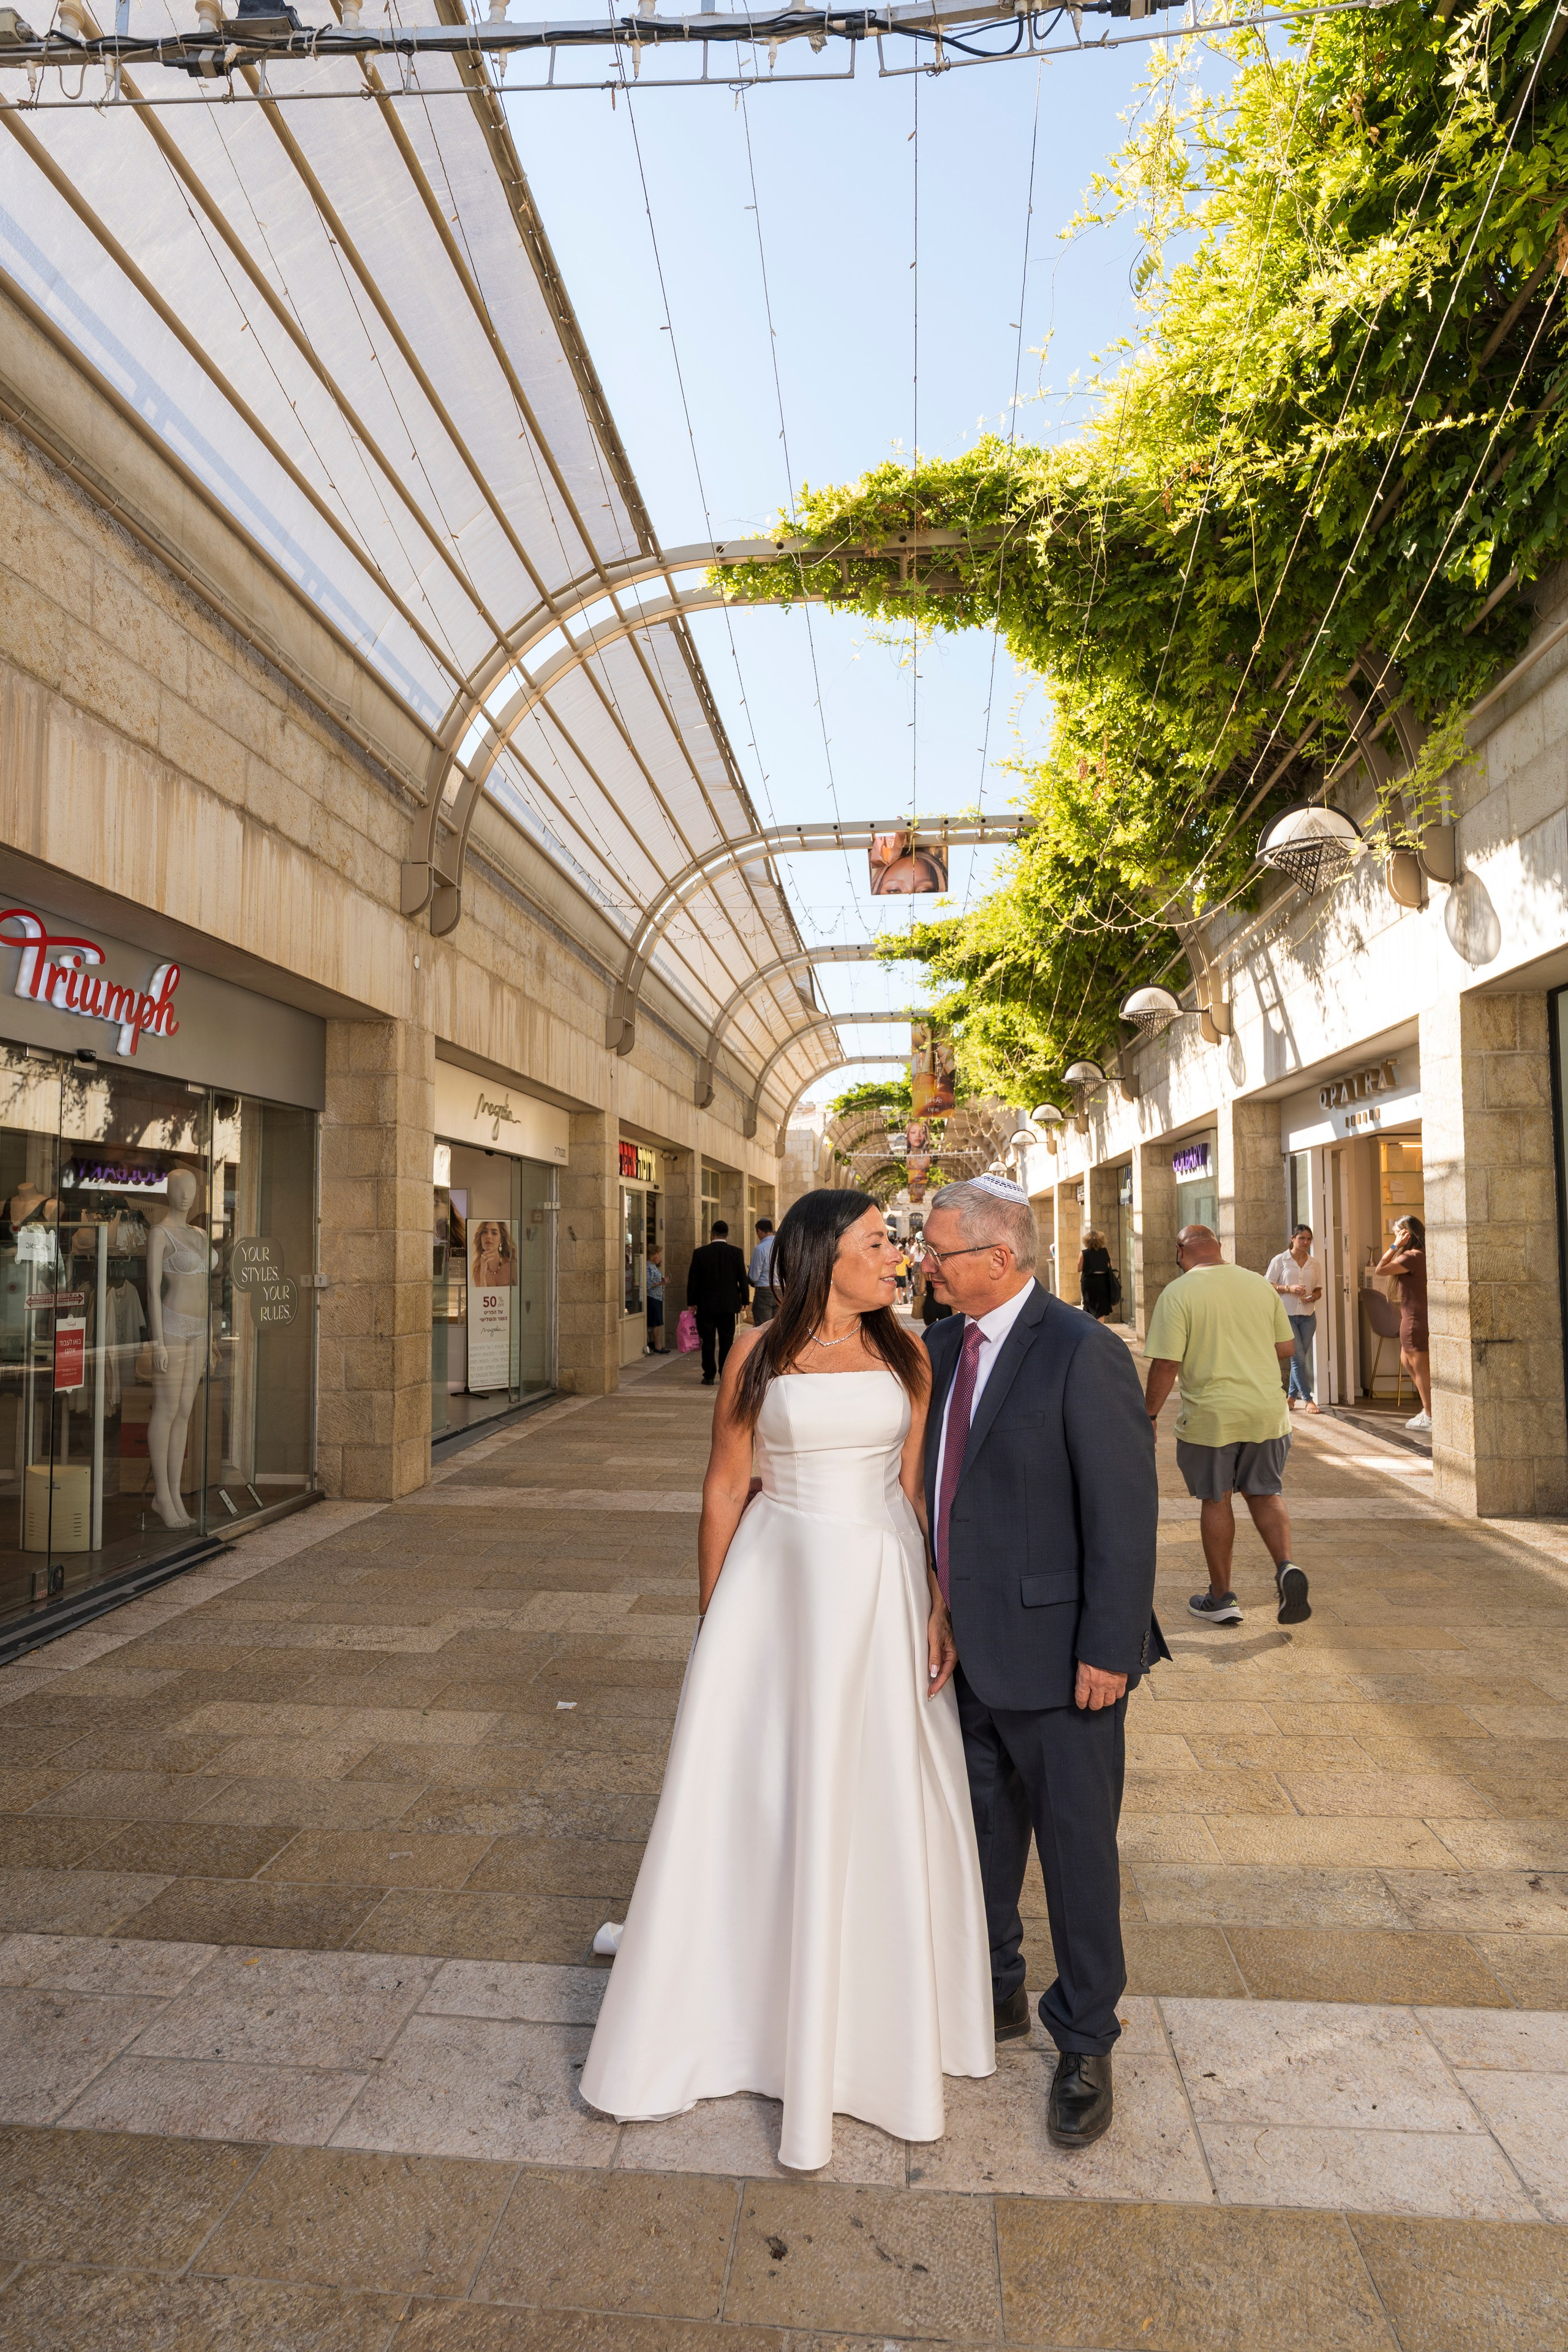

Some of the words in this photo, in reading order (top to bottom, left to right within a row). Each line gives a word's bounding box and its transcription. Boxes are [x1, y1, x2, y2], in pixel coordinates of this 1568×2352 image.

[0, 909, 179, 1056] Triumph
[1319, 1061, 1396, 1110] OPATRA
[241, 1246, 270, 1262] YOUR
[241, 1266, 280, 1283] STYLES.
[263, 1285, 290, 1301] YOUR
[260, 1304, 291, 1322] RULES.
